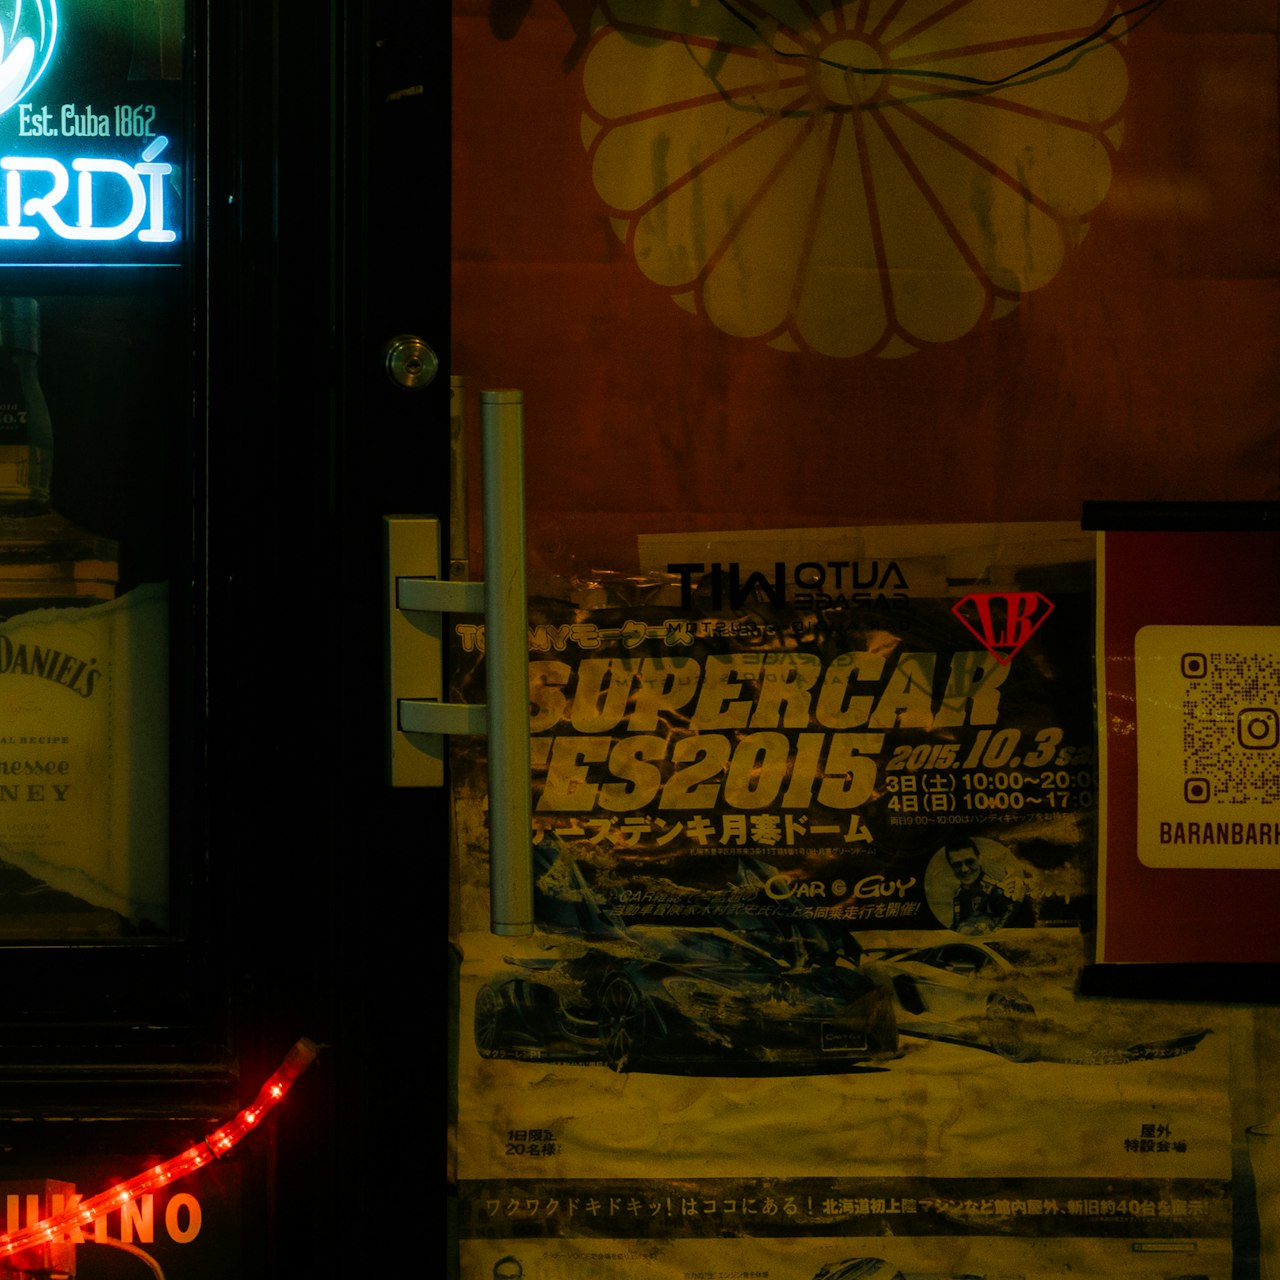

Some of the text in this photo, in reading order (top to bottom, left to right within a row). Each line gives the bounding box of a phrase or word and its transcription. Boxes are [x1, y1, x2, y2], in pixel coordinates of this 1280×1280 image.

[18, 103, 157, 137] Est. Cuba 1862
[529, 650, 1010, 733] SUPERCAR
[531, 732, 886, 812] ES2015
[852, 873, 917, 898] GUY
[1140, 1123, 1172, 1138] 屋外
[1124, 1138, 1187, 1154] 特設会場
